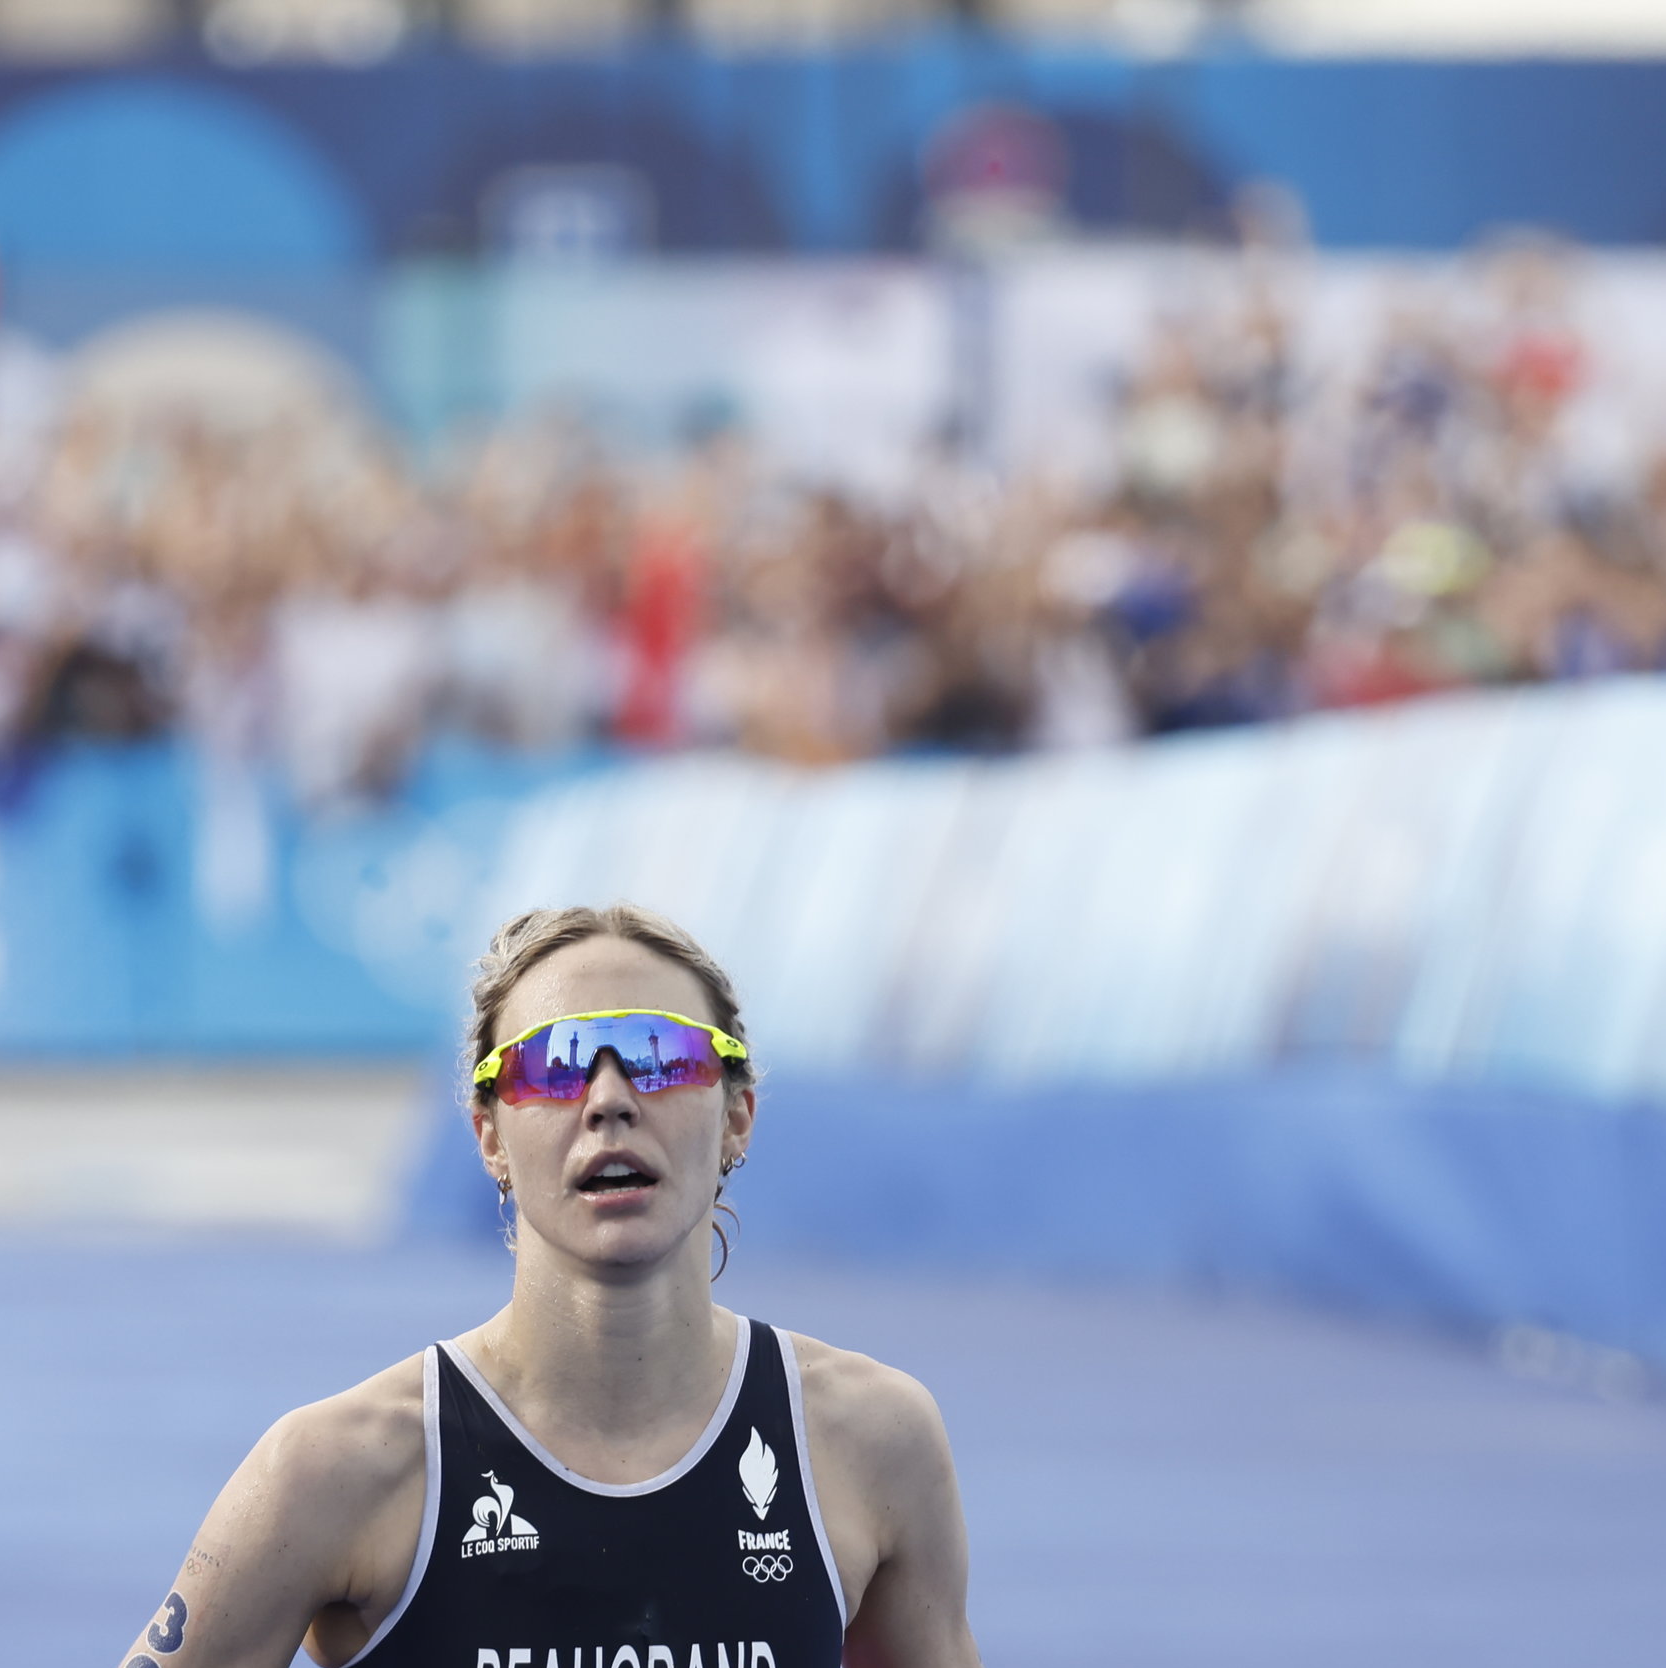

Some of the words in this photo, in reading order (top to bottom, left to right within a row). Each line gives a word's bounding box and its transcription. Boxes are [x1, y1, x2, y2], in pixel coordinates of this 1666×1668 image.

[461, 1543, 473, 1558] LE
[475, 1539, 495, 1555] COQ
[497, 1535, 540, 1551] SPORTIF
[737, 1528, 791, 1550] FRANCE
